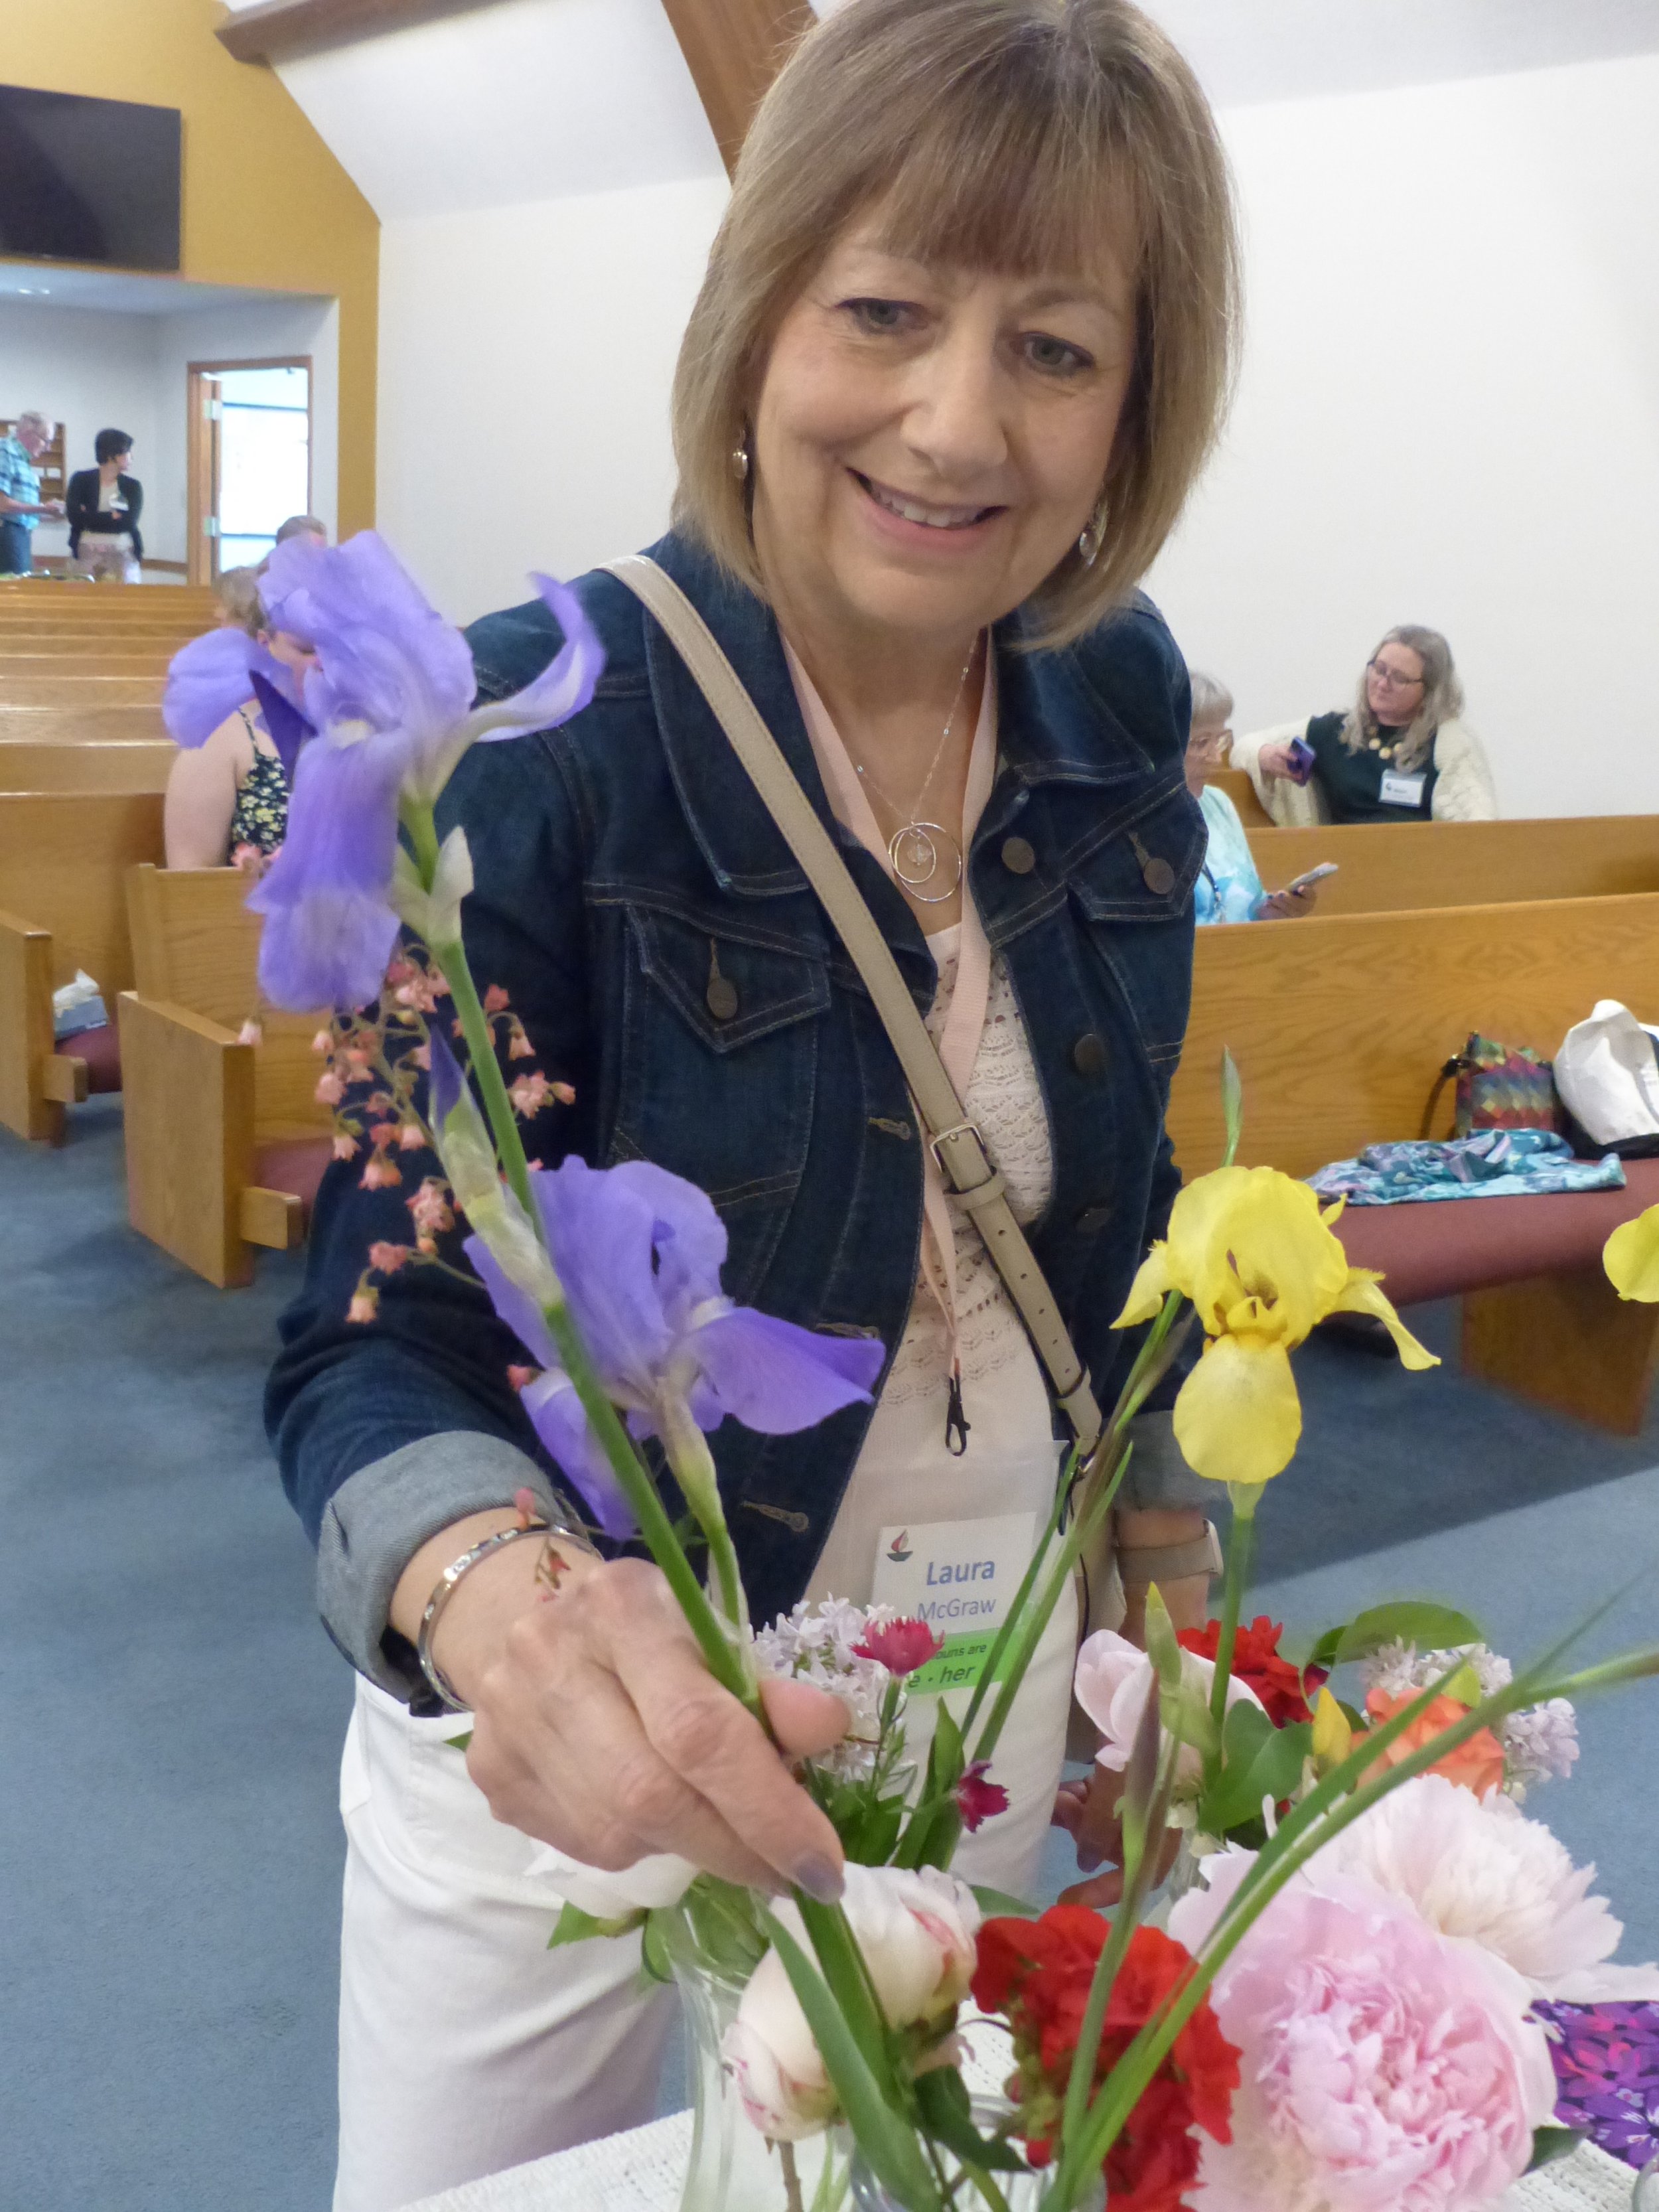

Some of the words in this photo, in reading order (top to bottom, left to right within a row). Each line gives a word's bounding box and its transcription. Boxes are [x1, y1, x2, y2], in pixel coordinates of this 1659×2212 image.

[926, 1560, 995, 1585] Laura
[917, 1598, 997, 1620] McGraw
[936, 1648, 964, 1659] ouns
[968, 1645, 987, 1655] are
[940, 1666, 975, 1684] her
